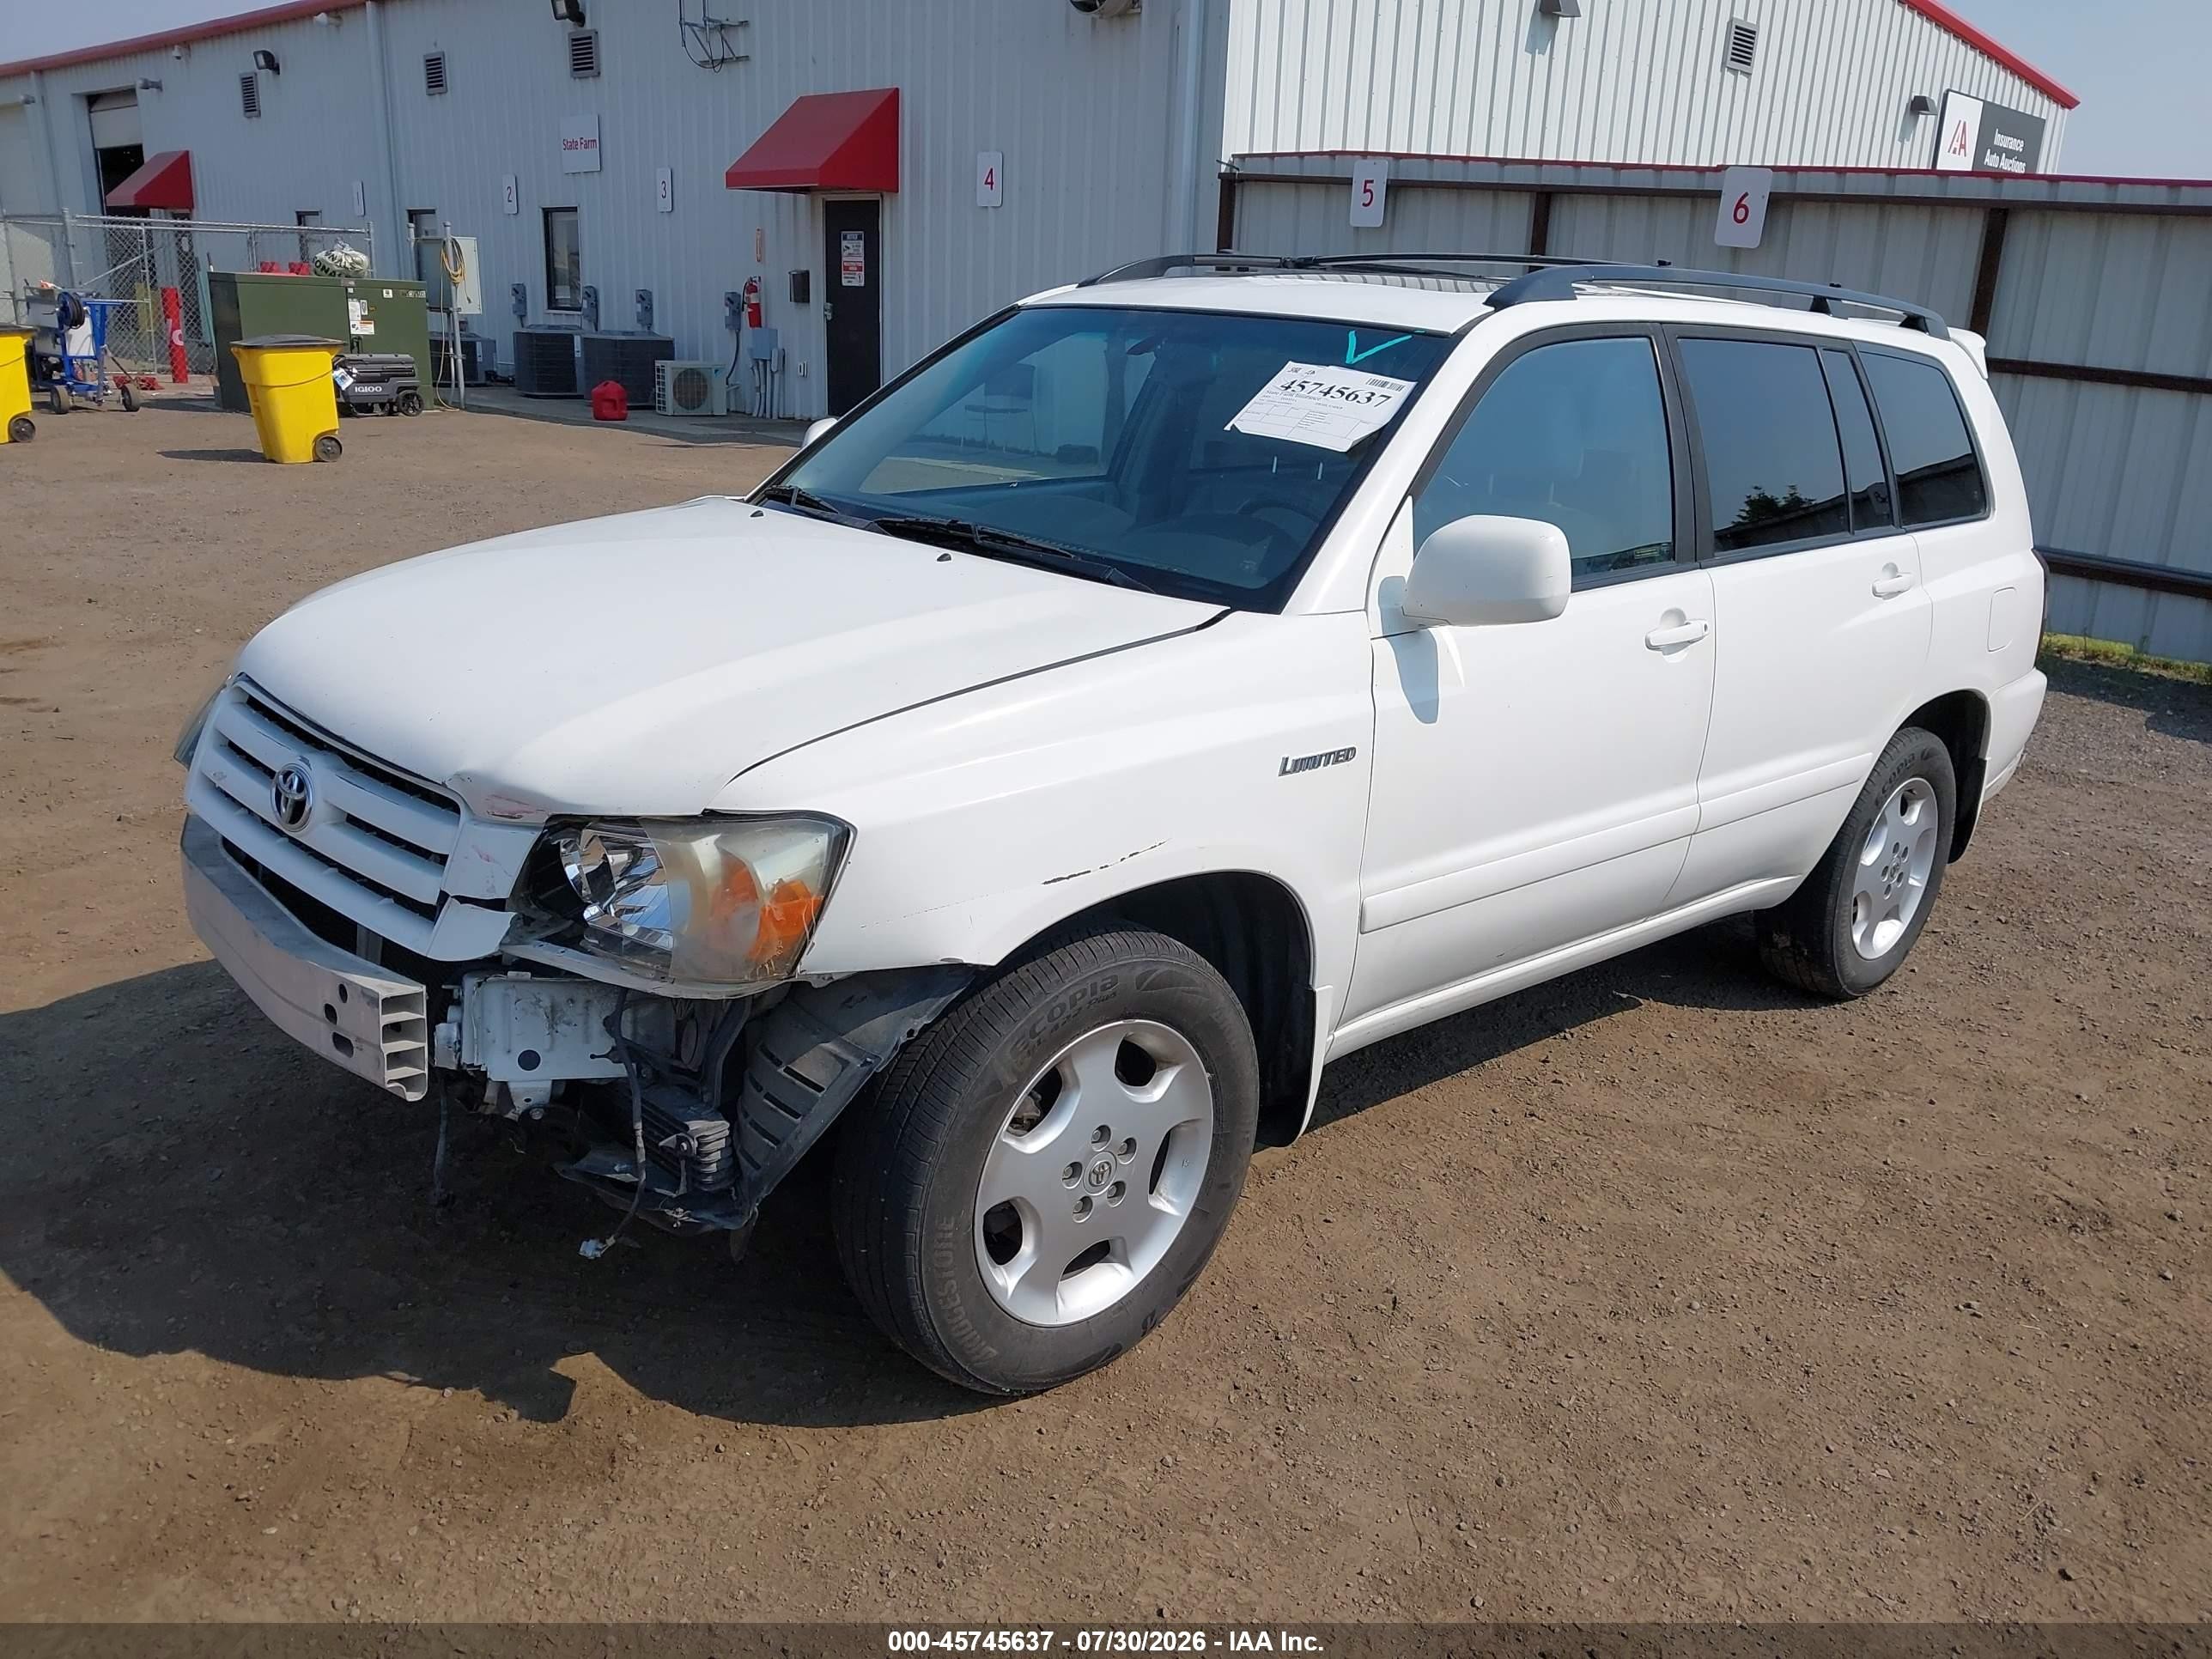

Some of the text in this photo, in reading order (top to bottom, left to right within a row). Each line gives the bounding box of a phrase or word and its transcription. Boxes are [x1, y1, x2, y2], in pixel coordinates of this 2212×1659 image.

[562, 137, 598, 151] State Farm
[1993, 128, 2025, 153] Insurance
[1984, 149, 2027, 173] Auto Auctions
[661, 179, 667, 198] 3
[984, 167, 994, 191] 4
[507, 185, 514, 203] 2
[1362, 179, 1375, 208] 5
[1733, 191, 1749, 224] 6
[1279, 379, 1394, 408] 45745637
